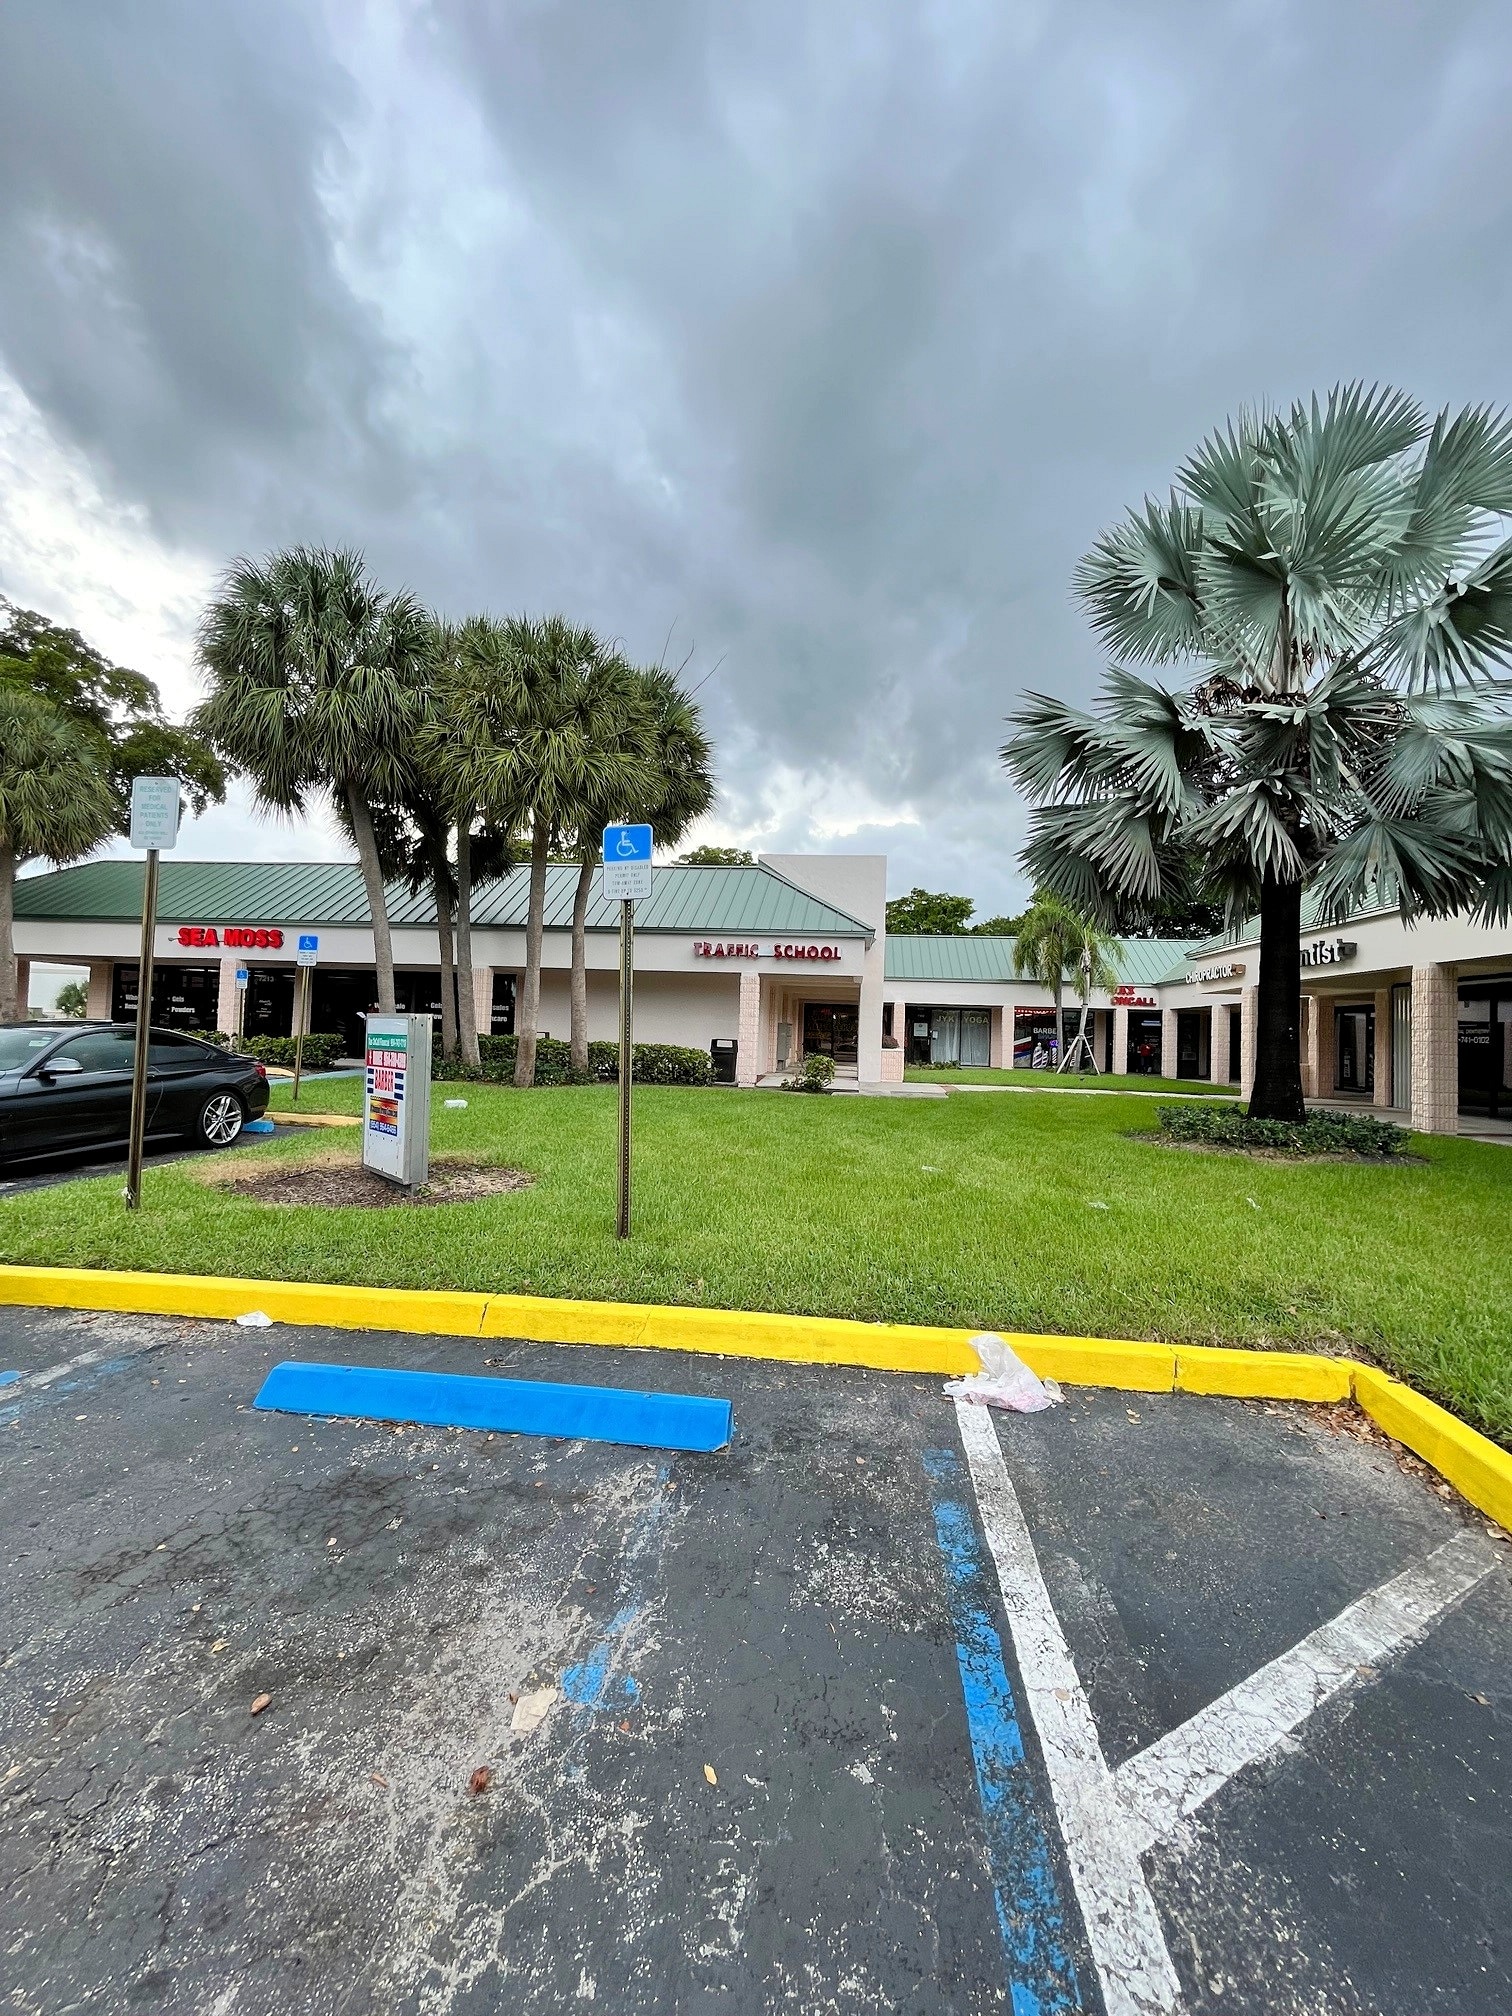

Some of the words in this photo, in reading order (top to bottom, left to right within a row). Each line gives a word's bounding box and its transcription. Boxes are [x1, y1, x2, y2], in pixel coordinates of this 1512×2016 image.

[139, 785, 172, 793] RESERVED
[141, 803, 168, 811] MEDICAL
[139, 811, 169, 819] PATIENTS
[145, 820, 162, 828] ONLY
[178, 927, 219, 947] SEA
[223, 928, 285, 949] MOSS
[693, 942, 759, 958] TRAFFIC
[773, 943, 841, 960] SCHOOL
[1300, 939, 1343, 966] ntist
[1185, 964, 1233, 983] CHIROPRACTOR
[963, 1016, 989, 1024] YOGA
[1032, 1027, 1057, 1035] BARBE
